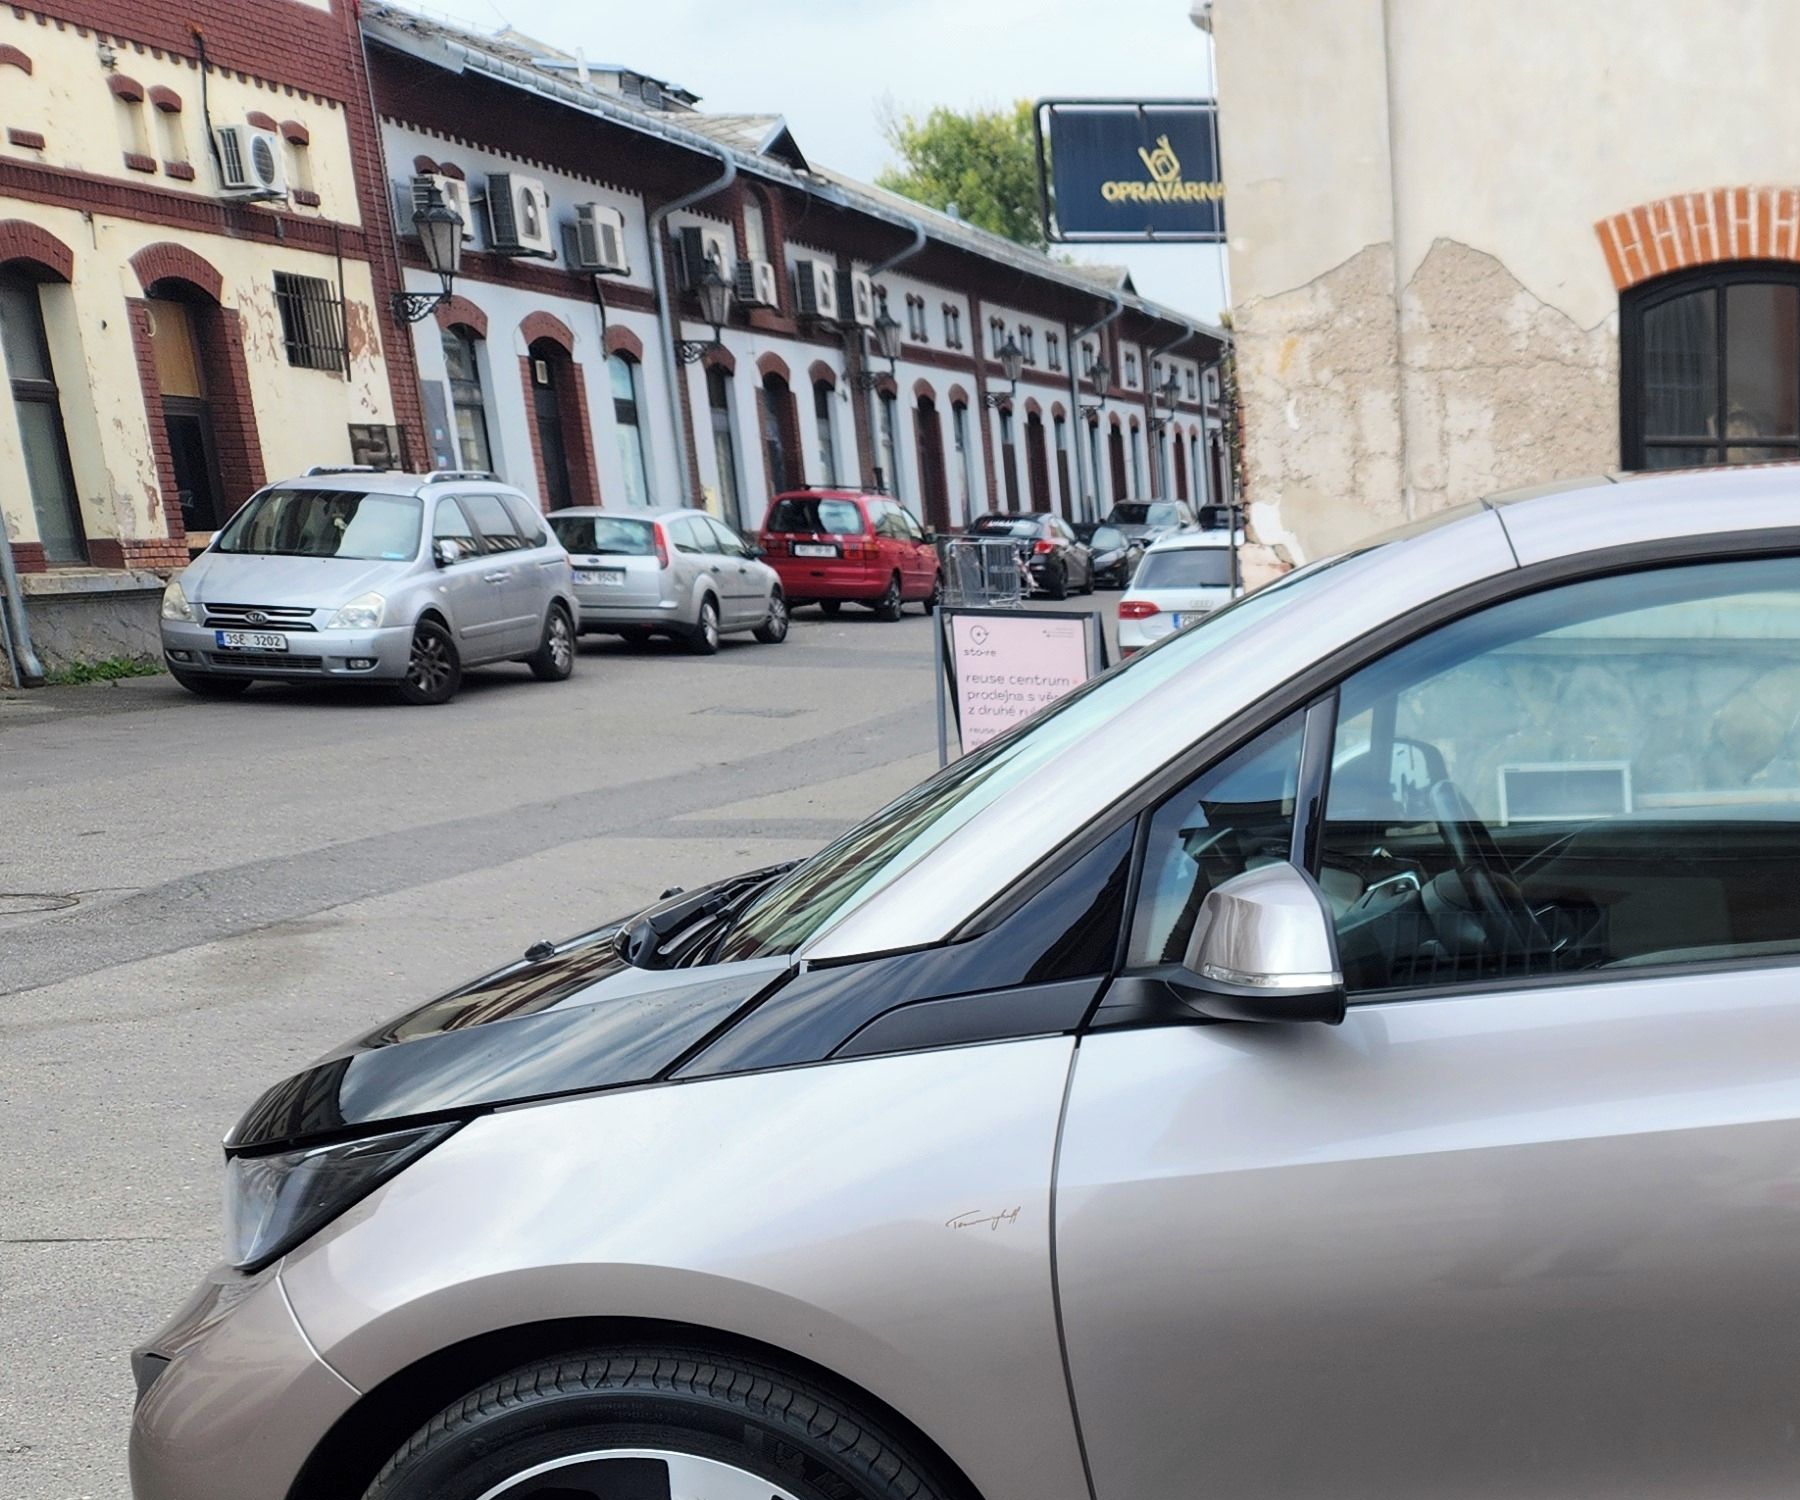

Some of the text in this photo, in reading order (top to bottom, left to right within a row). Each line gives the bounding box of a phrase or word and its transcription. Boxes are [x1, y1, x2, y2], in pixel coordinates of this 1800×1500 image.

[226, 634, 281, 646] 3SE 3202
[966, 674, 1069, 685] reuse centrum
[967, 690, 1024, 703] prodejna
[978, 705, 1015, 716] druhé
